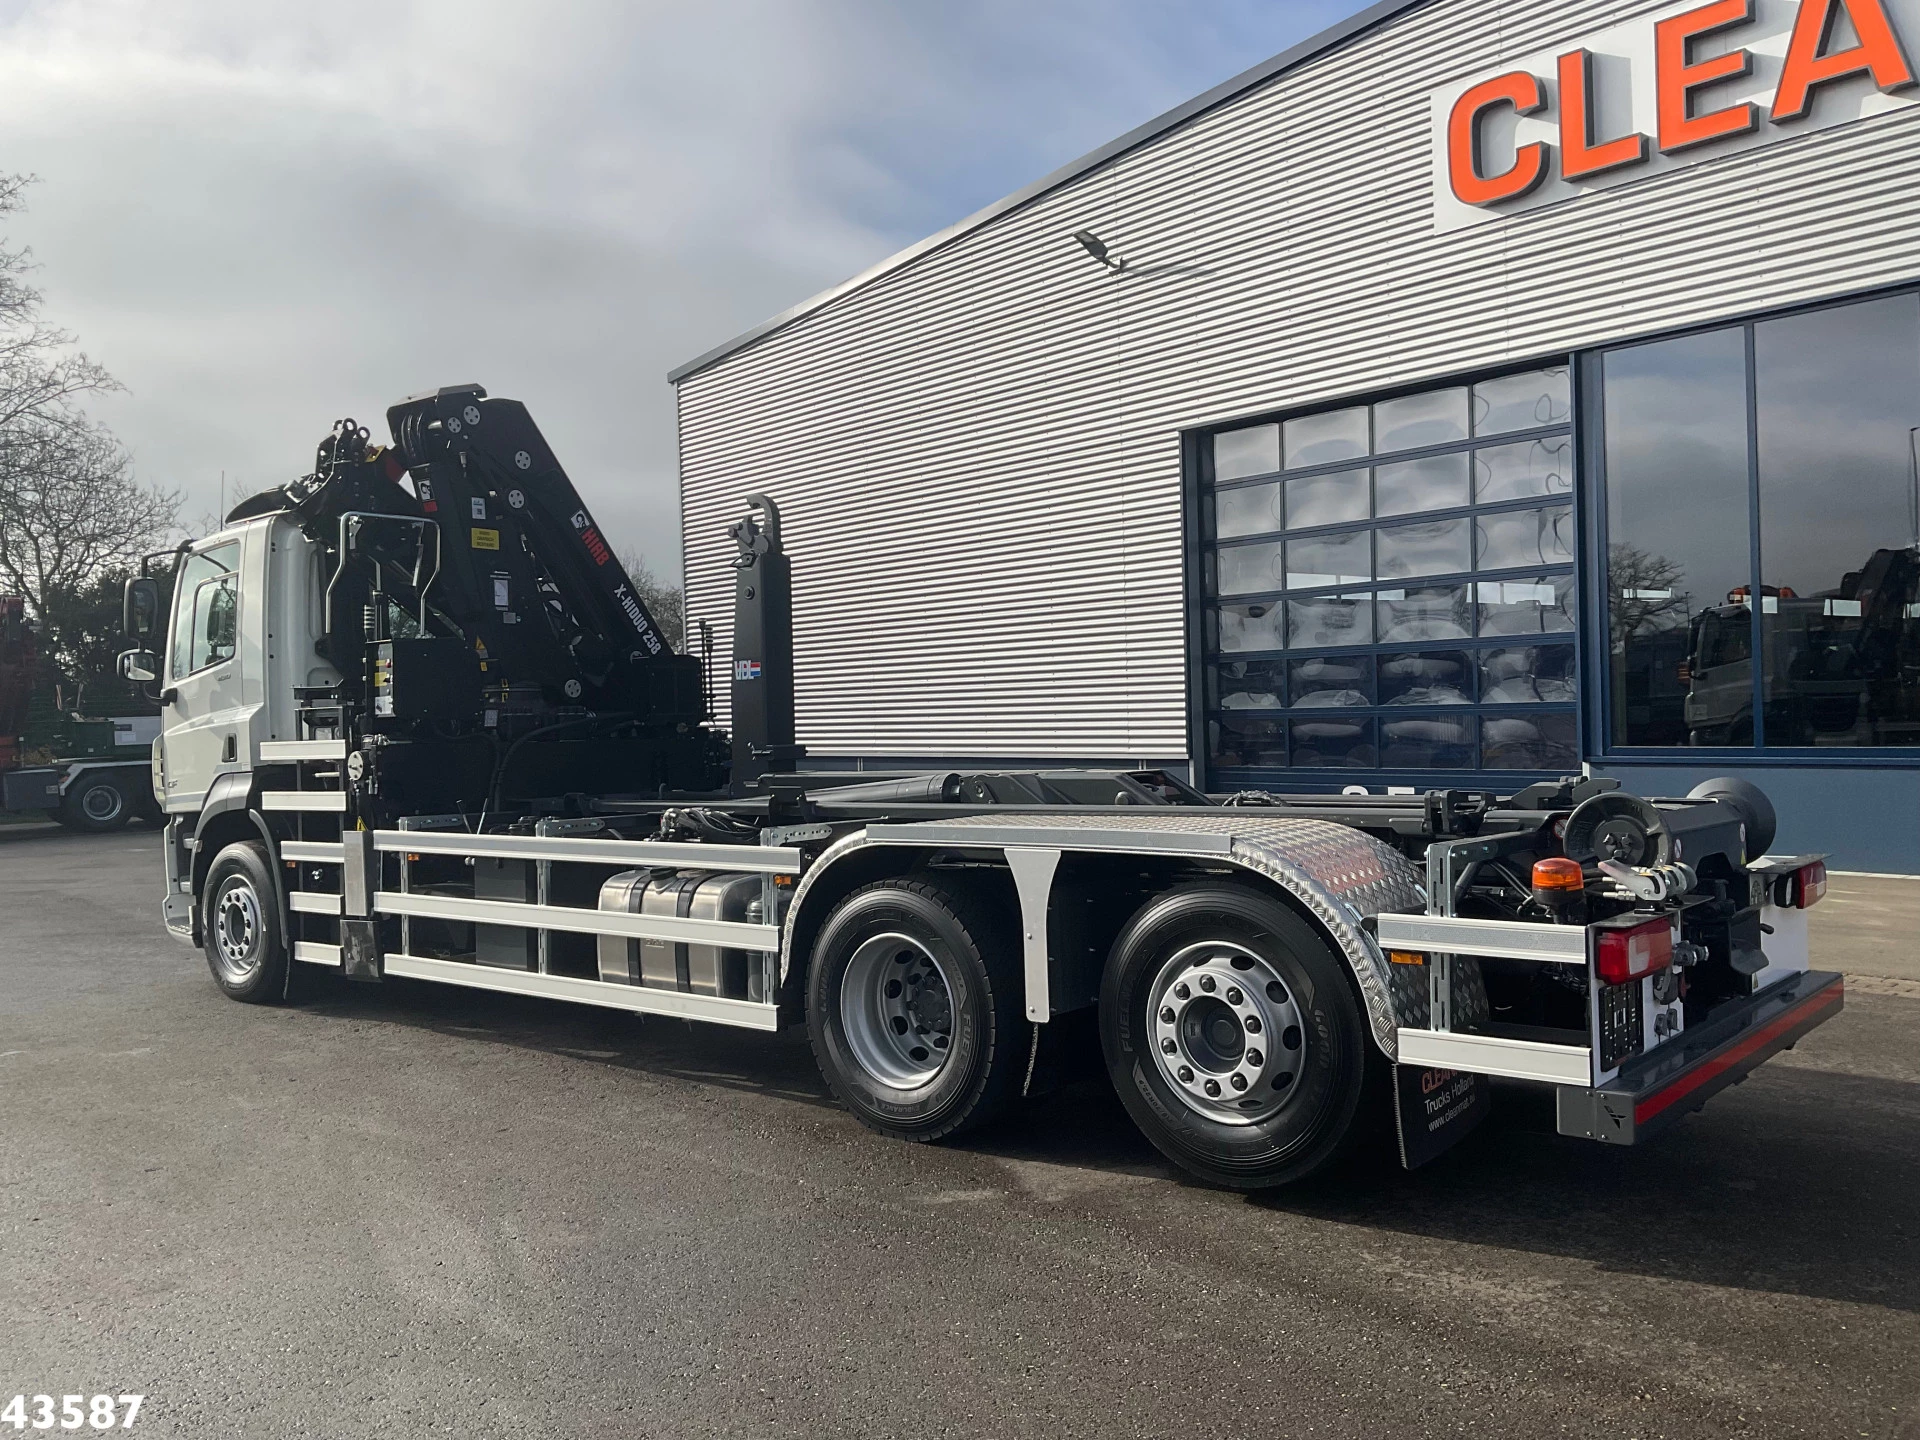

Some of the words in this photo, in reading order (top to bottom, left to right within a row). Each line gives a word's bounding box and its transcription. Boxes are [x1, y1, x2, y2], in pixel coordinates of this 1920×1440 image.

[1447, 0, 1915, 208] CLEA
[582, 527, 610, 566] HIAB
[613, 583, 648, 633] X-HIDUO
[642, 629, 662, 655] 258
[1424, 1091, 1451, 1115] Trucks
[1451, 1074, 1475, 1099] Holland
